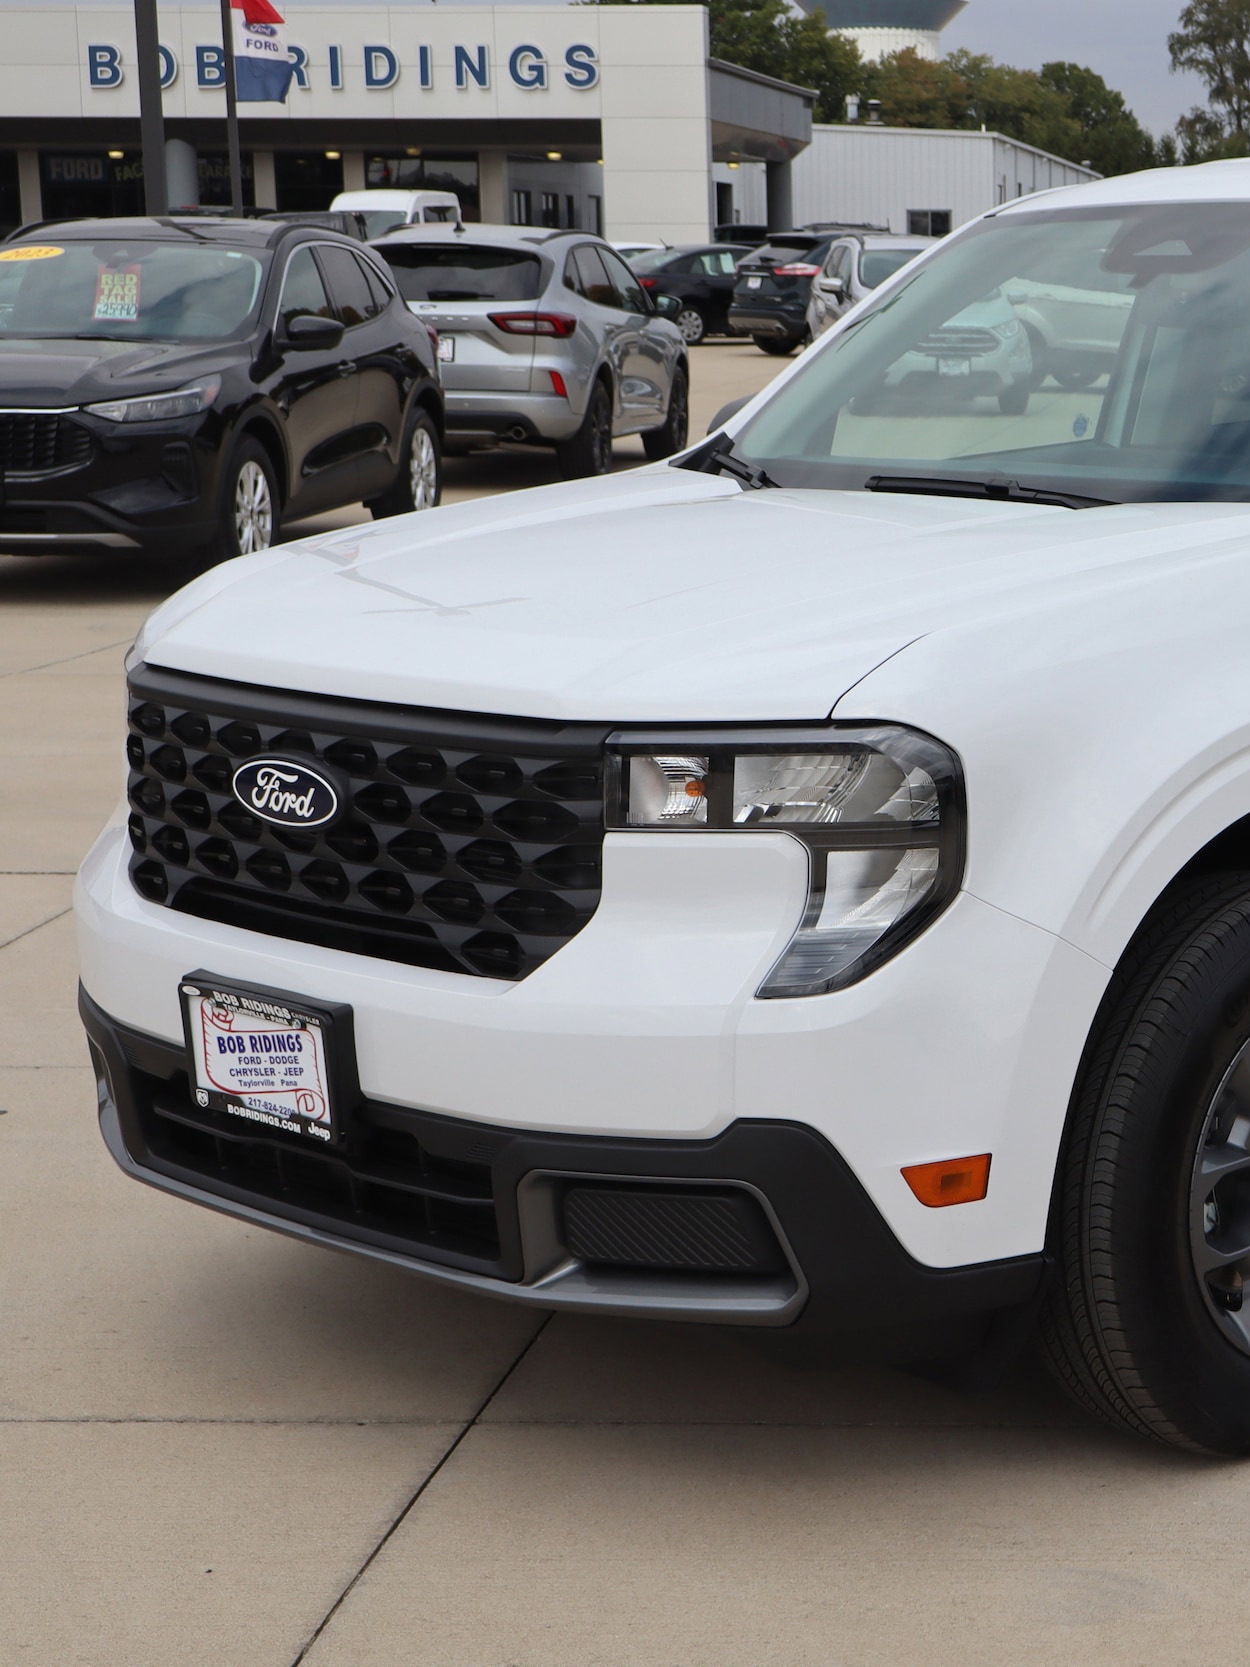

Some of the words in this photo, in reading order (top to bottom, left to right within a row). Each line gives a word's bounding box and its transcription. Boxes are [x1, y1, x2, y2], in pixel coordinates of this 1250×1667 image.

[246, 38, 279, 52] FORD
[50, 158, 103, 180] FORD
[101, 273, 138, 286] RED
[101, 285, 137, 297] TAG
[251, 767, 316, 818] Ford
[212, 990, 240, 1007] BOB
[240, 997, 292, 1020] RIDINGS
[217, 1035, 246, 1054] BOB
[249, 1033, 303, 1053] RIDINGS
[238, 1056, 262, 1065] FORD
[269, 1055, 300, 1065] DODGE
[229, 1067, 276, 1077] CHRYSLER
[283, 1067, 304, 1076] JEEP
[238, 1079, 275, 1088] Taylorville
[280, 1079, 298, 1087] Pana
[227, 1103, 302, 1134] BOBRIDINGS.COM
[307, 1121, 331, 1142] Jeep
